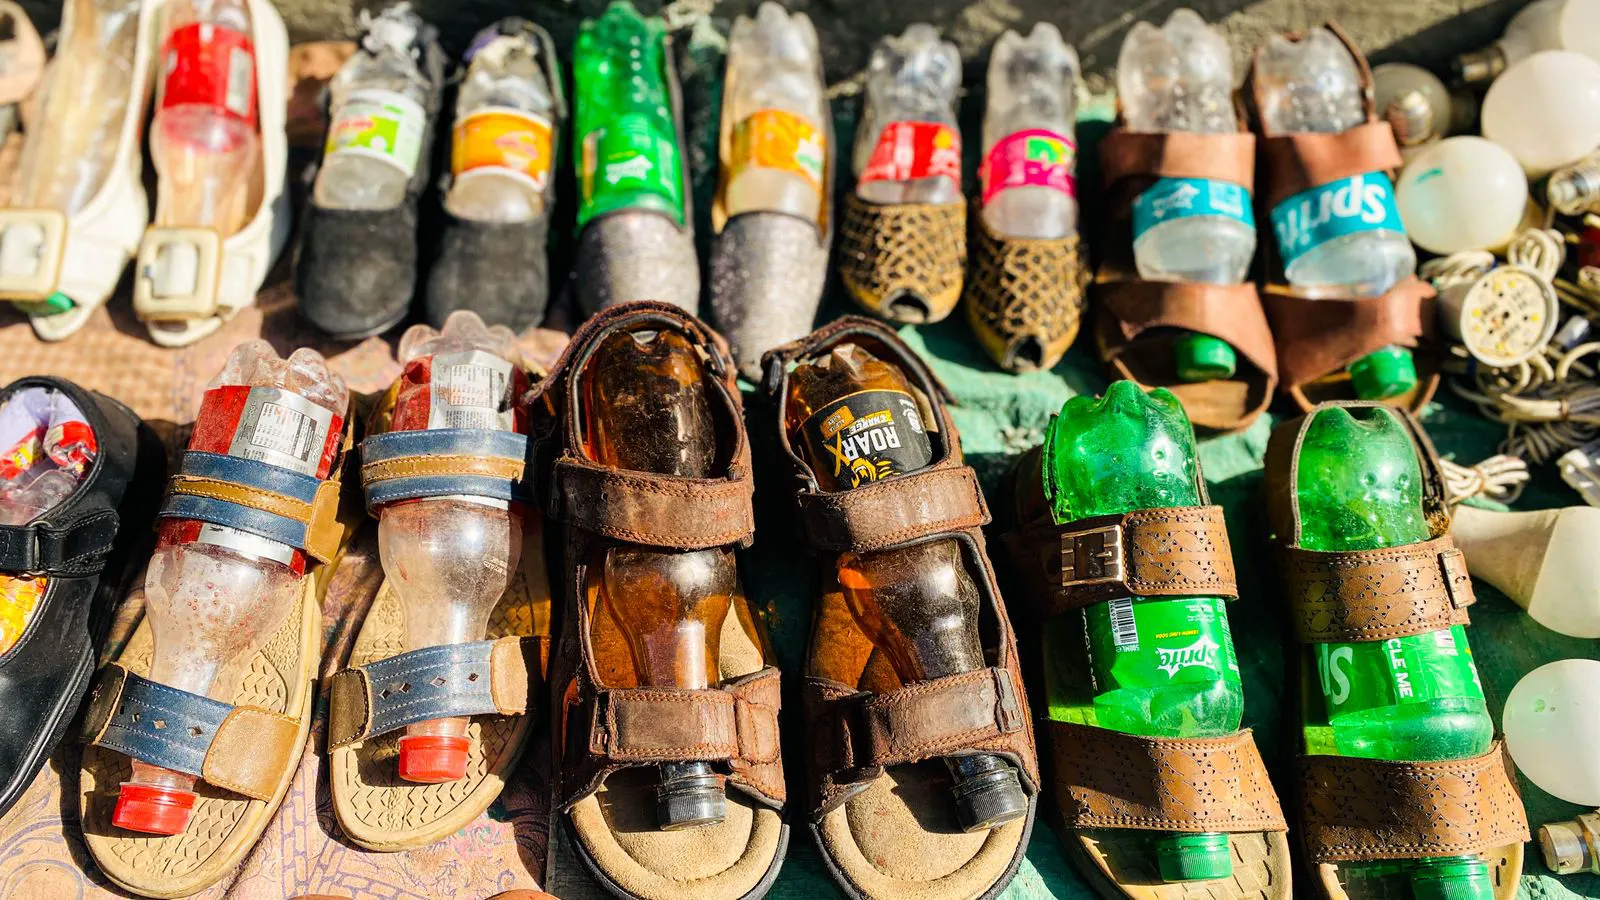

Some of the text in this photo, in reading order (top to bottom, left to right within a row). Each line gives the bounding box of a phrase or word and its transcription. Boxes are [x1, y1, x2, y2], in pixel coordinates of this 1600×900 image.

[841, 425, 901, 460] ROAR
[1159, 644, 1216, 670] Sprite
[1395, 672, 1414, 699] ME
